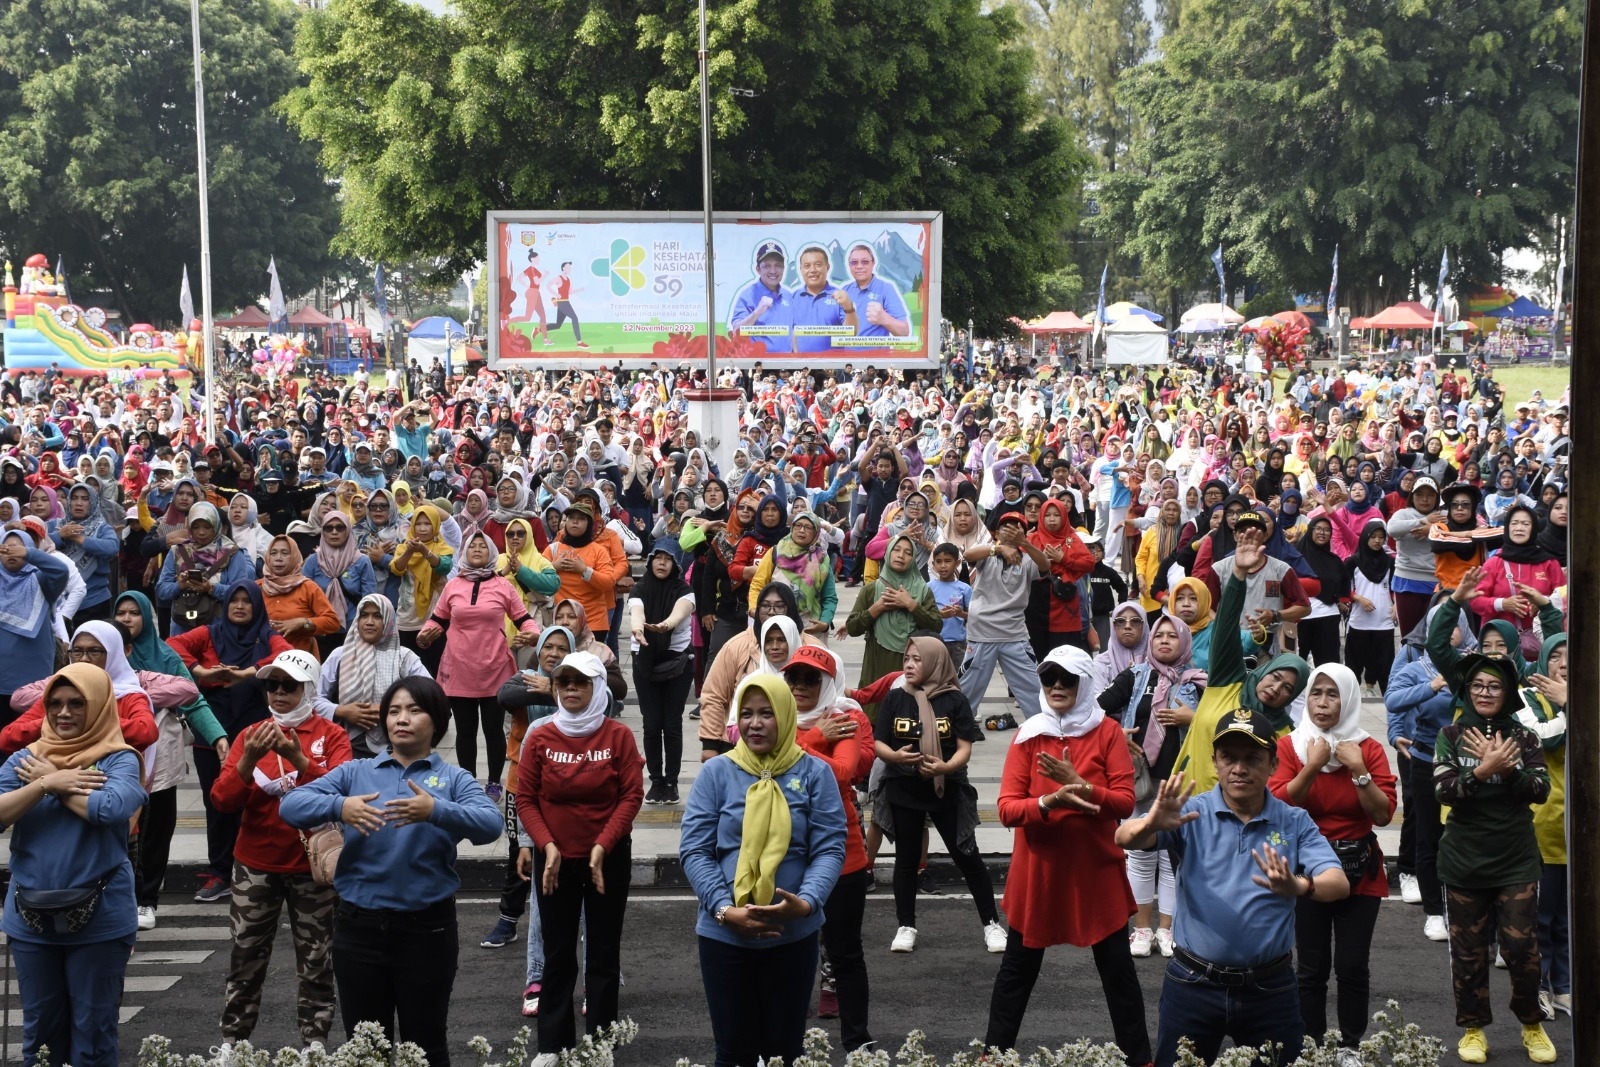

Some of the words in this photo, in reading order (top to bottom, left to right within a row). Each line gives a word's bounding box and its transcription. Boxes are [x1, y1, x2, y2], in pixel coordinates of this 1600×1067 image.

[653, 241, 680, 251] HARI
[654, 275, 682, 298] 59
[679, 310, 698, 318] Maju
[623, 324, 634, 332] 12
[635, 324, 673, 332] November
[674, 324, 695, 332] 2023
[545, 748, 584, 764] GIRLS
[584, 747, 612, 762] ARE
